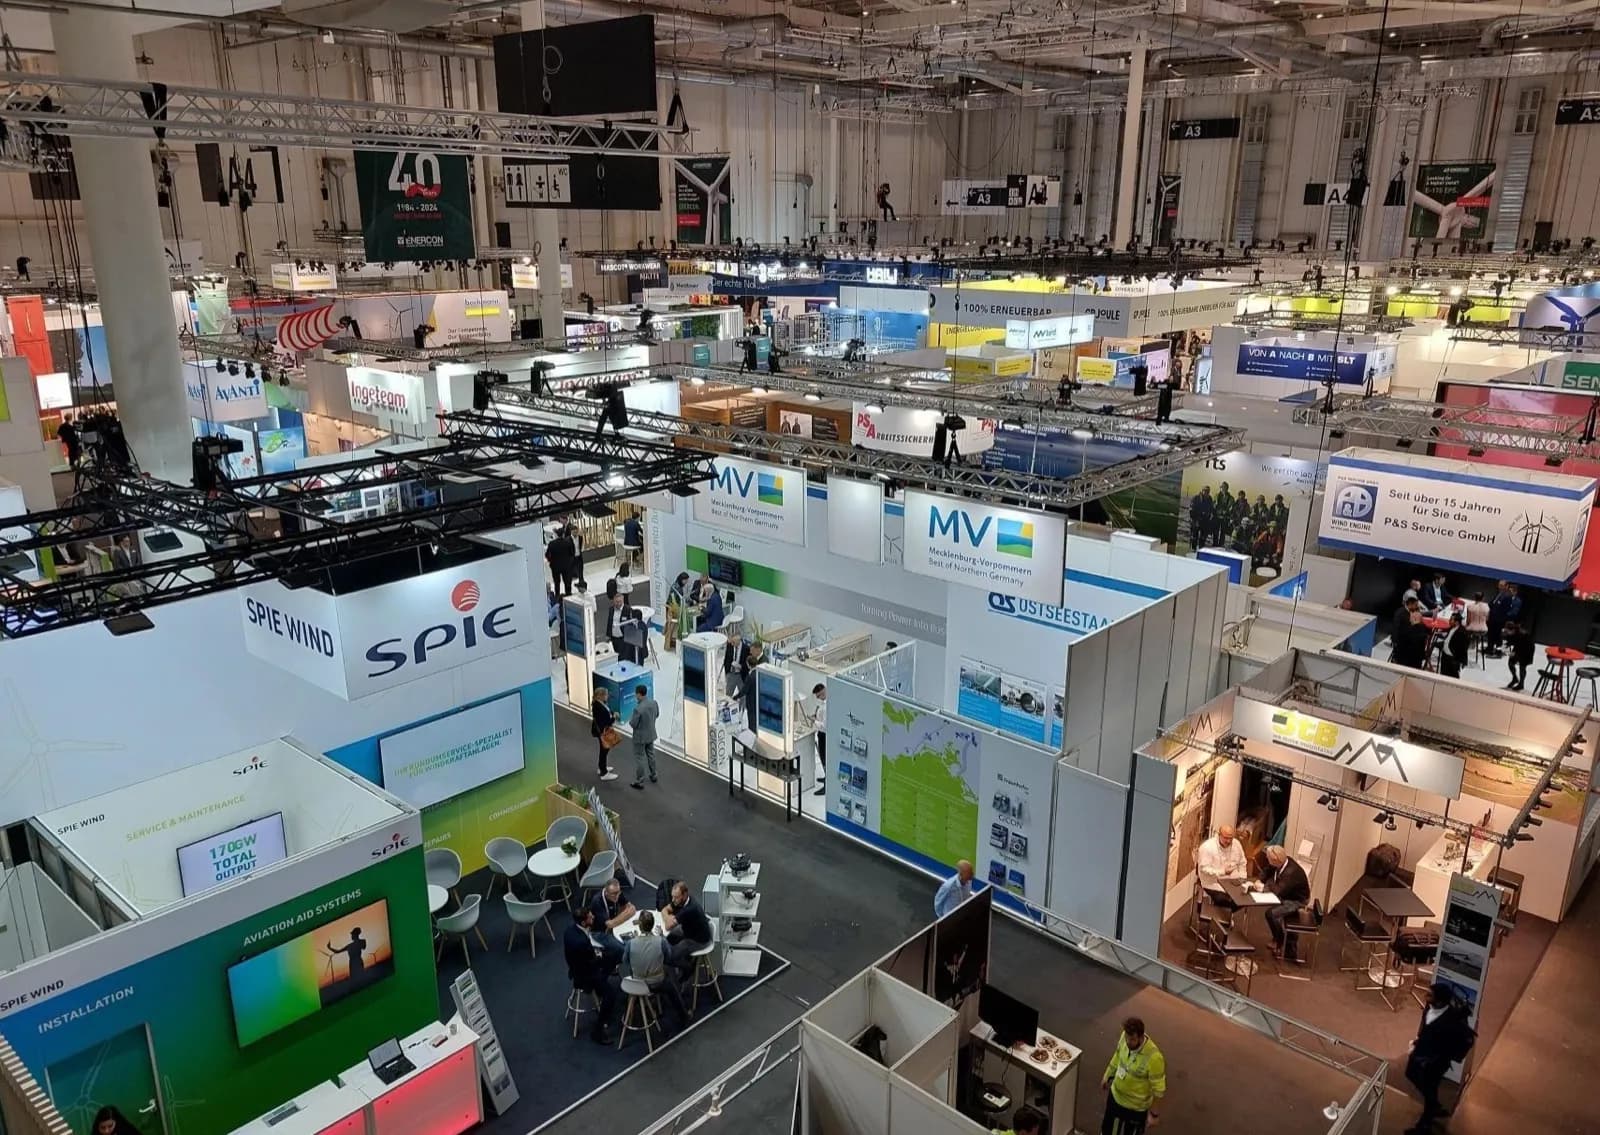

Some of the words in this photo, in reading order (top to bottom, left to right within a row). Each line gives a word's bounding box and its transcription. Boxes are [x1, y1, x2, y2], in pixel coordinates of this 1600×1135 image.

[1185, 125, 1201, 137] A3
[230, 158, 257, 198] A4
[388, 152, 441, 191] 40
[558, 168, 568, 176] WC
[420, 203, 438, 211] 2024
[977, 193, 991, 204] A3
[406, 236, 443, 244] ENERCON
[964, 304, 988, 313] 100%
[1249, 348, 1267, 358] VON
[1280, 352, 1305, 360] NACH
[1318, 355, 1333, 363] MIT
[1338, 356, 1356, 364] SLT
[351, 380, 406, 408] Ingeteam
[710, 464, 754, 498] MV
[1388, 488, 1411, 500] Seit
[1413, 494, 1439, 507] über
[1443, 498, 1456, 508] 15
[1459, 500, 1502, 515] Jahren
[1412, 504, 1428, 516] für
[1432, 508, 1449, 518] Sie
[1452, 512, 1471, 523] da.
[929, 504, 993, 548] MV
[1332, 519, 1348, 527] WIND
[1384, 516, 1408, 530] P&S
[1410, 521, 1454, 538] Service
[1458, 528, 1496, 545] GmbH
[928, 546, 1032, 576] Mecklenburg-Vorpommern
[928, 558, 944, 569] Best
[944, 562, 953, 570] of
[954, 564, 988, 578] Northern
[989, 571, 1024, 588] Germany
[247, 597, 283, 636] SPIE
[284, 613, 334, 658] WIND
[365, 602, 517, 678] SPIE
[232, 756, 269, 777] SPIE
[57, 822, 78, 836] SPIE
[79, 814, 105, 828] WIND
[126, 820, 169, 842] SERVICE
[179, 794, 246, 826] MAINTENANCE
[210, 833, 257, 860] 170GW
[371, 834, 411, 857] SPIE
[213, 849, 256, 872] TOTAL
[215, 860, 257, 882] OUTPUT
[242, 917, 296, 948] AVIATION
[296, 909, 315, 926] AID
[315, 888, 362, 919] SYSTEMS
[0, 994, 28, 1012] SPIE
[30, 979, 64, 1000] WIND
[38, 985, 134, 1034] INSTALLATION
